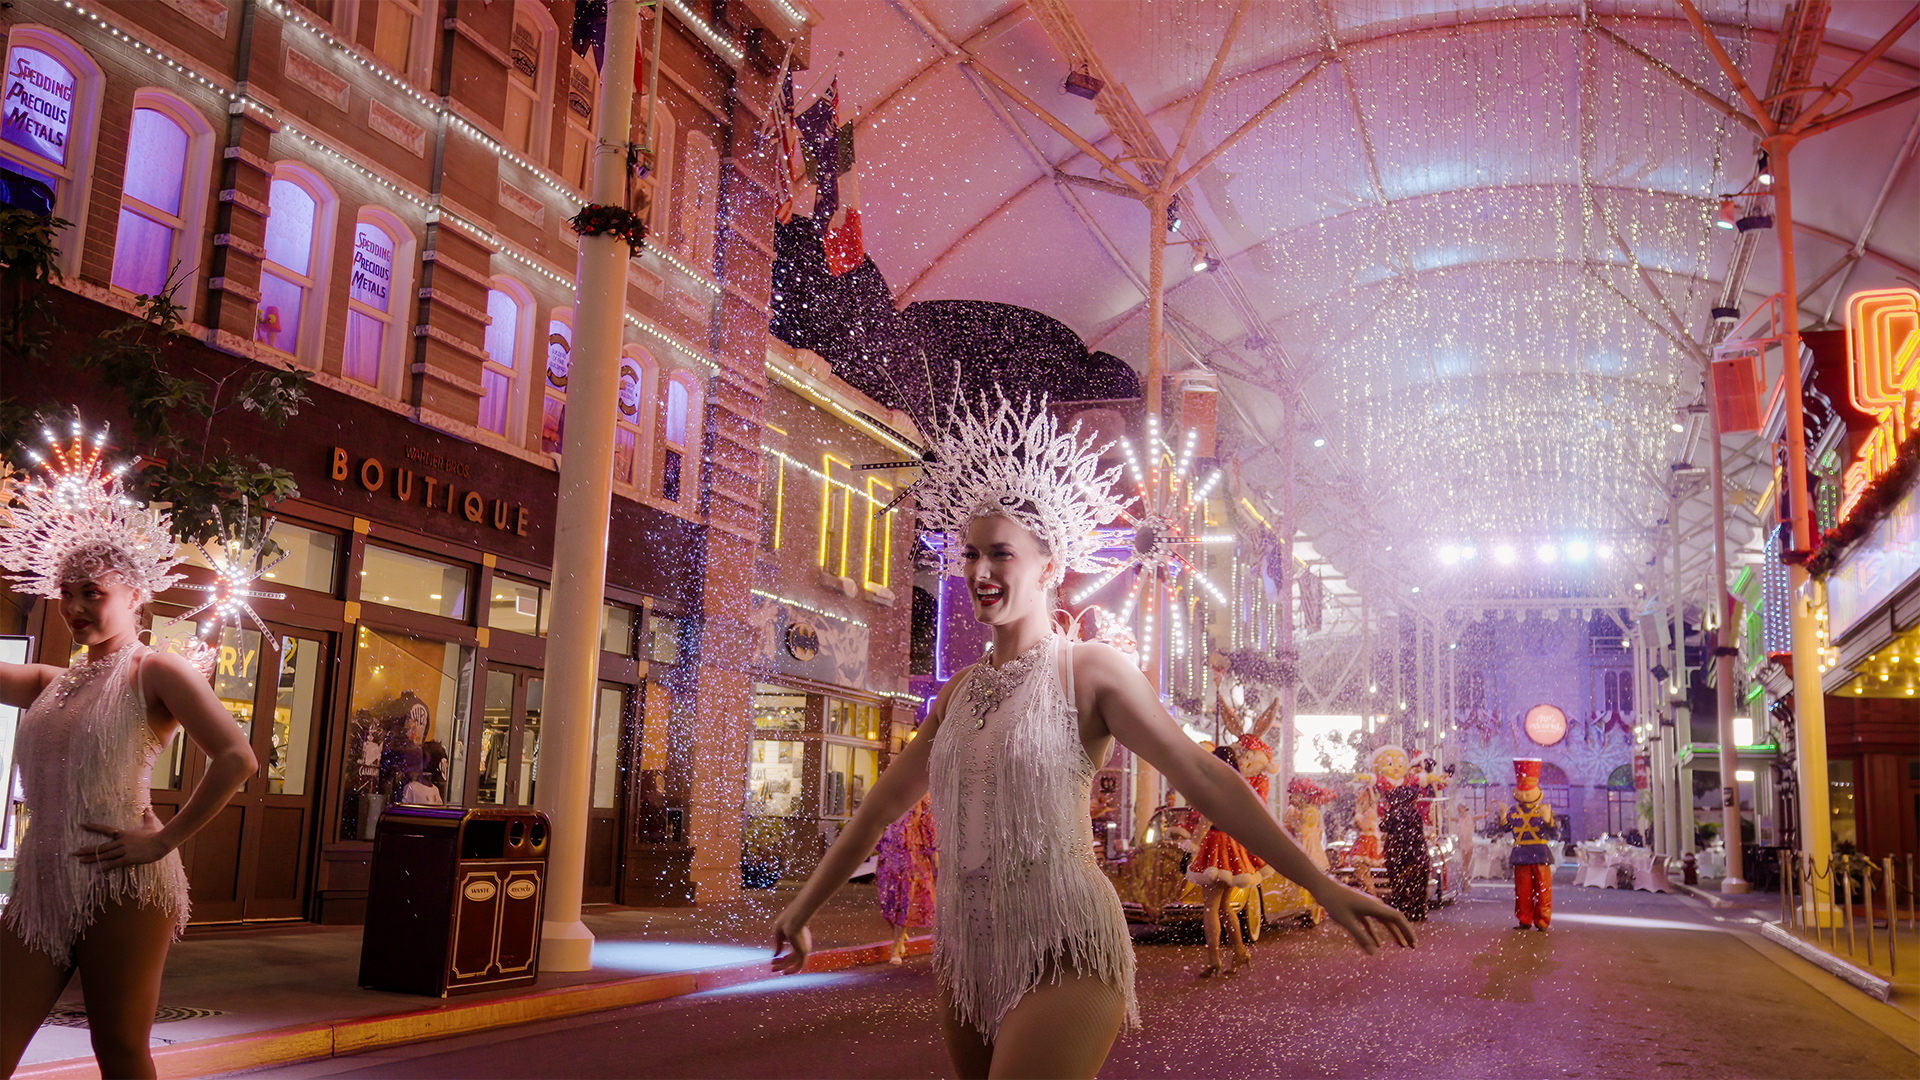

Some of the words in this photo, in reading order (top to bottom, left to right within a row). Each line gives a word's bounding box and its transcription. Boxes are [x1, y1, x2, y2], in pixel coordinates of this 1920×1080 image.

[9, 57, 72, 102] SPEDDING
[5, 81, 68, 125] PRECIOUS
[5, 106, 64, 147] METALS
[355, 231, 391, 262] SPEDDING
[353, 251, 390, 281] PRECIOUS
[351, 270, 386, 299] METALS
[405, 445, 444, 470] WARNER
[331, 446, 529, 537] BOUTIQUE
